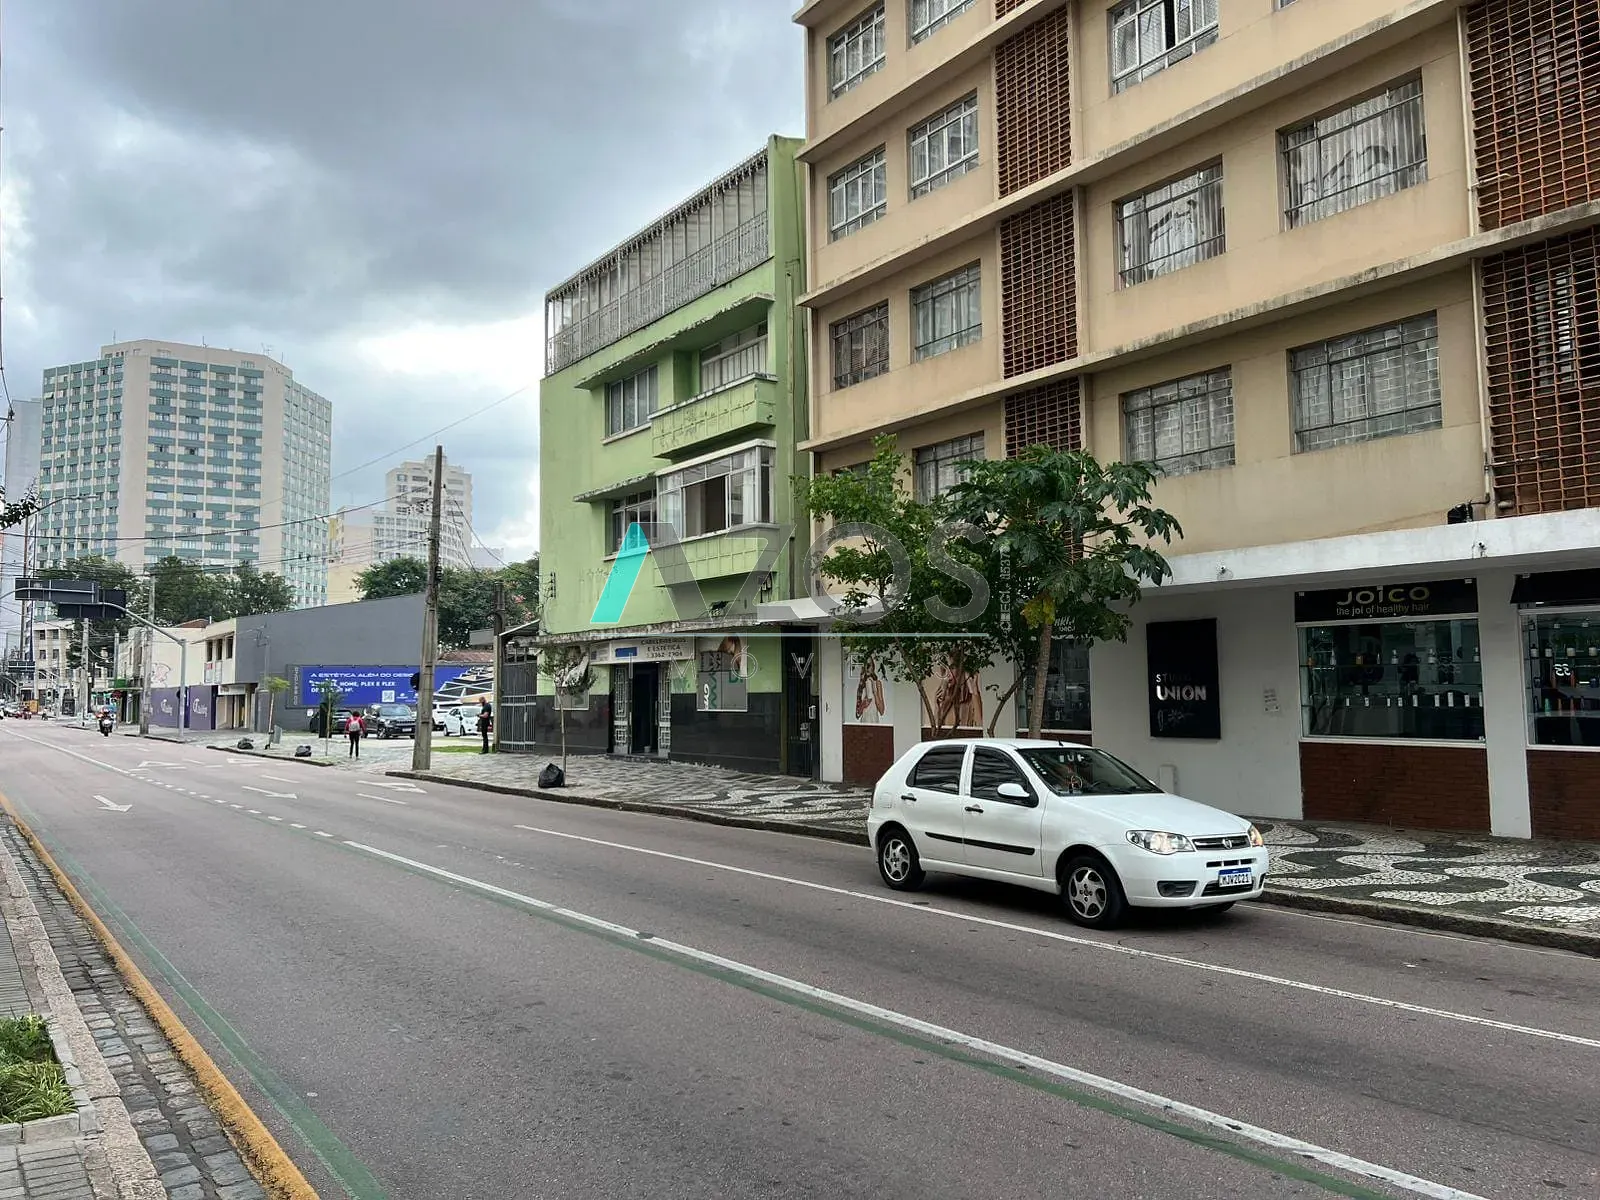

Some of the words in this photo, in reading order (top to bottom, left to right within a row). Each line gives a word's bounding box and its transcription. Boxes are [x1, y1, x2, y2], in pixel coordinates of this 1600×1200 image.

[1336, 607, 1350, 616] the
[1365, 604, 1375, 614] of
[1376, 603, 1410, 614] healthy
[1411, 602, 1430, 612] hair
[1156, 685, 1207, 701] UNION
